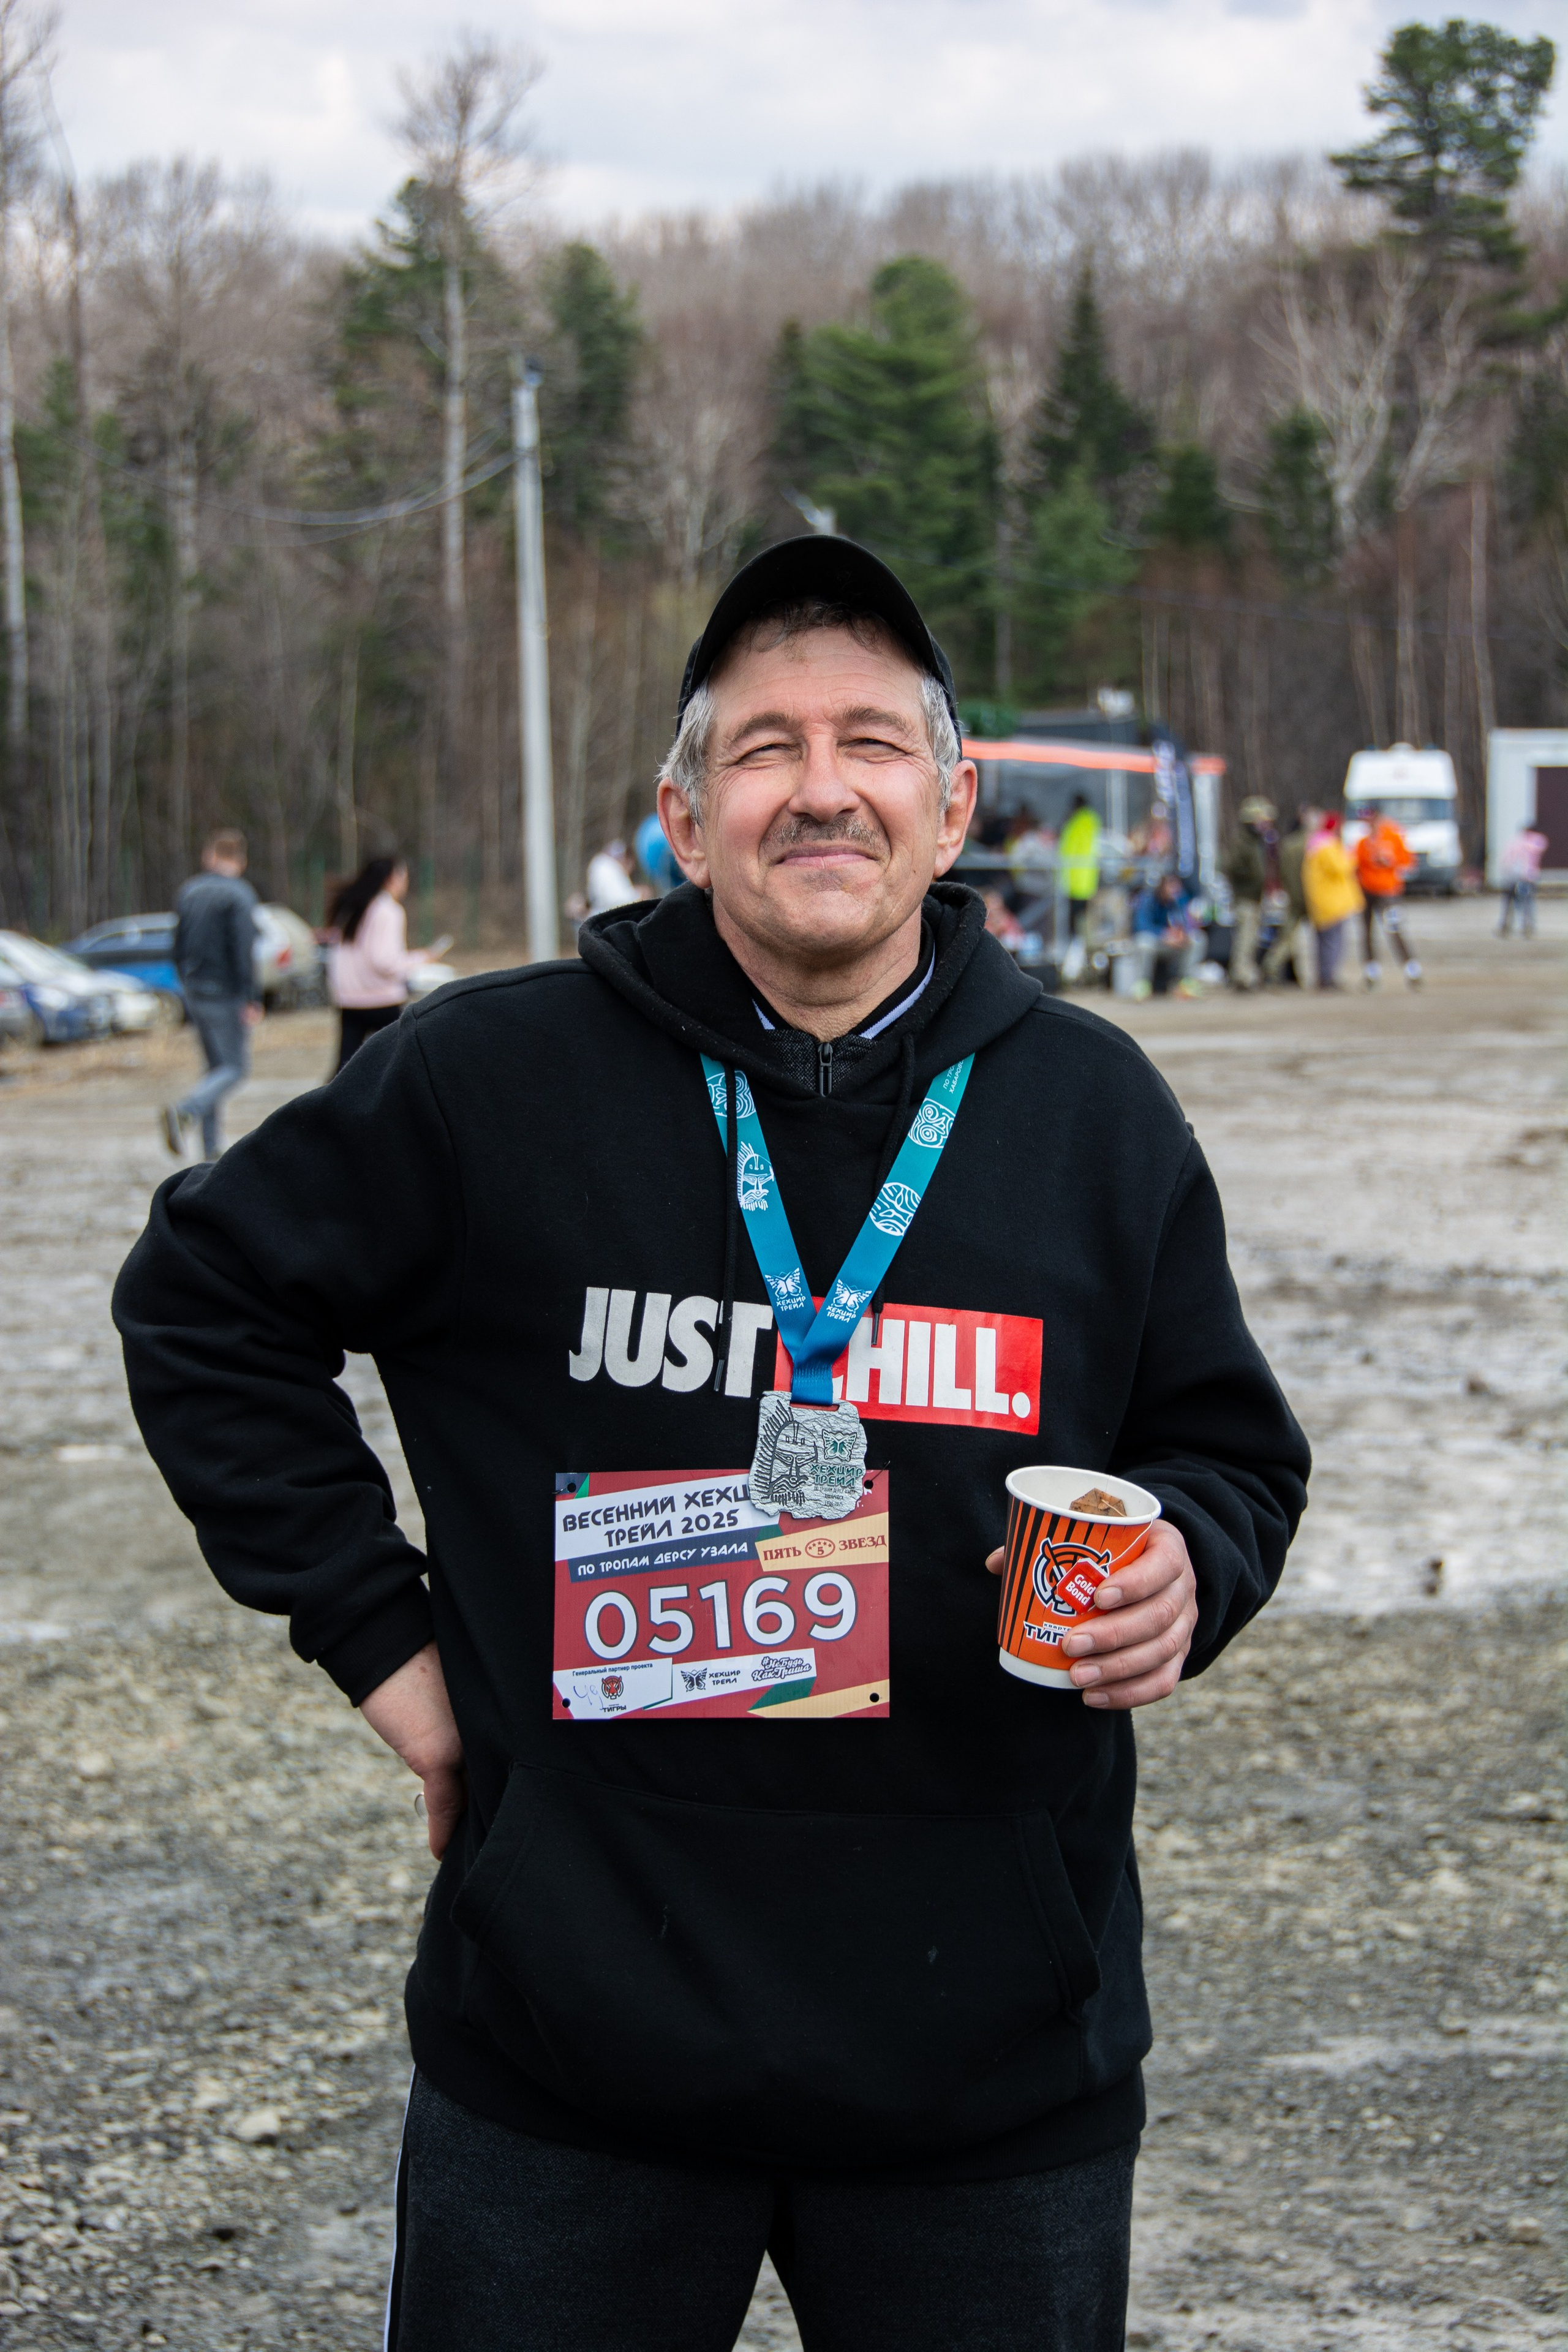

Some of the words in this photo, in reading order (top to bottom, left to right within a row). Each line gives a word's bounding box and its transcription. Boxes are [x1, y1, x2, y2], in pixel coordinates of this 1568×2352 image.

[943, 1079, 950, 1090] ПО
[949, 1060, 964, 1094] ХАБАРОВС
[776, 1296, 806, 1307] ХЕХЦИР
[826, 1305, 856, 1319] ХЕХЦИР
[569, 1287, 774, 1398] JUST
[833, 1317, 1031, 1419] HILL.
[809, 1463, 863, 1478] ХЕХЦИР
[563, 1495, 676, 1532] ВЕСЕННИЙ
[684, 1483, 750, 1510] ХЕХЦ
[605, 1520, 673, 1547] ТРЕЙЛ
[681, 1509, 740, 1534] 2025
[578, 1563, 595, 1576] ПО
[600, 1555, 650, 1573] ТРОПАМ
[654, 1548, 697, 1565] ДЕРСУ
[701, 1542, 748, 1558] УЗАЛА
[763, 1547, 802, 1561] ПЯТЬ
[817, 1547, 824, 1556] 5
[839, 1535, 888, 1551] ЗВЕЗД
[1065, 1581, 1091, 1605] Bond
[1074, 1574, 1096, 1595] Gold
[584, 1572, 858, 1660] 05169
[1023, 1621, 1065, 1645] ТИГ
[572, 1667, 607, 1676] Генеральный
